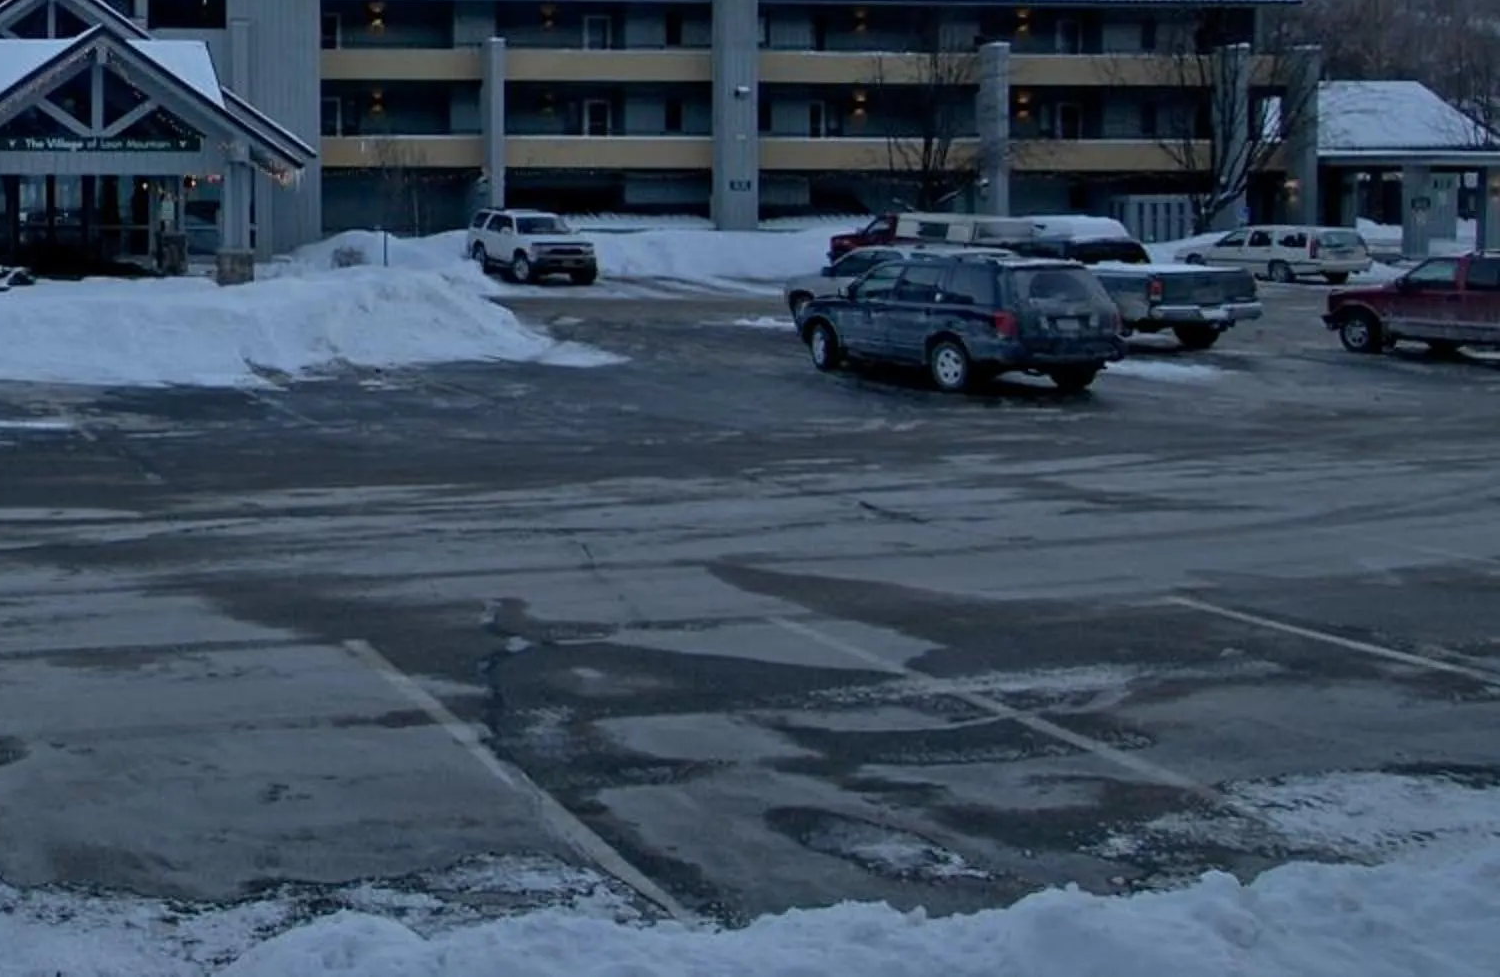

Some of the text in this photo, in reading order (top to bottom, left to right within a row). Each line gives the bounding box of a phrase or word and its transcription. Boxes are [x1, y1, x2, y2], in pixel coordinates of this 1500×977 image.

[25, 138, 44, 149] The
[47, 138, 84, 152] Village
[87, 138, 98, 149] of
